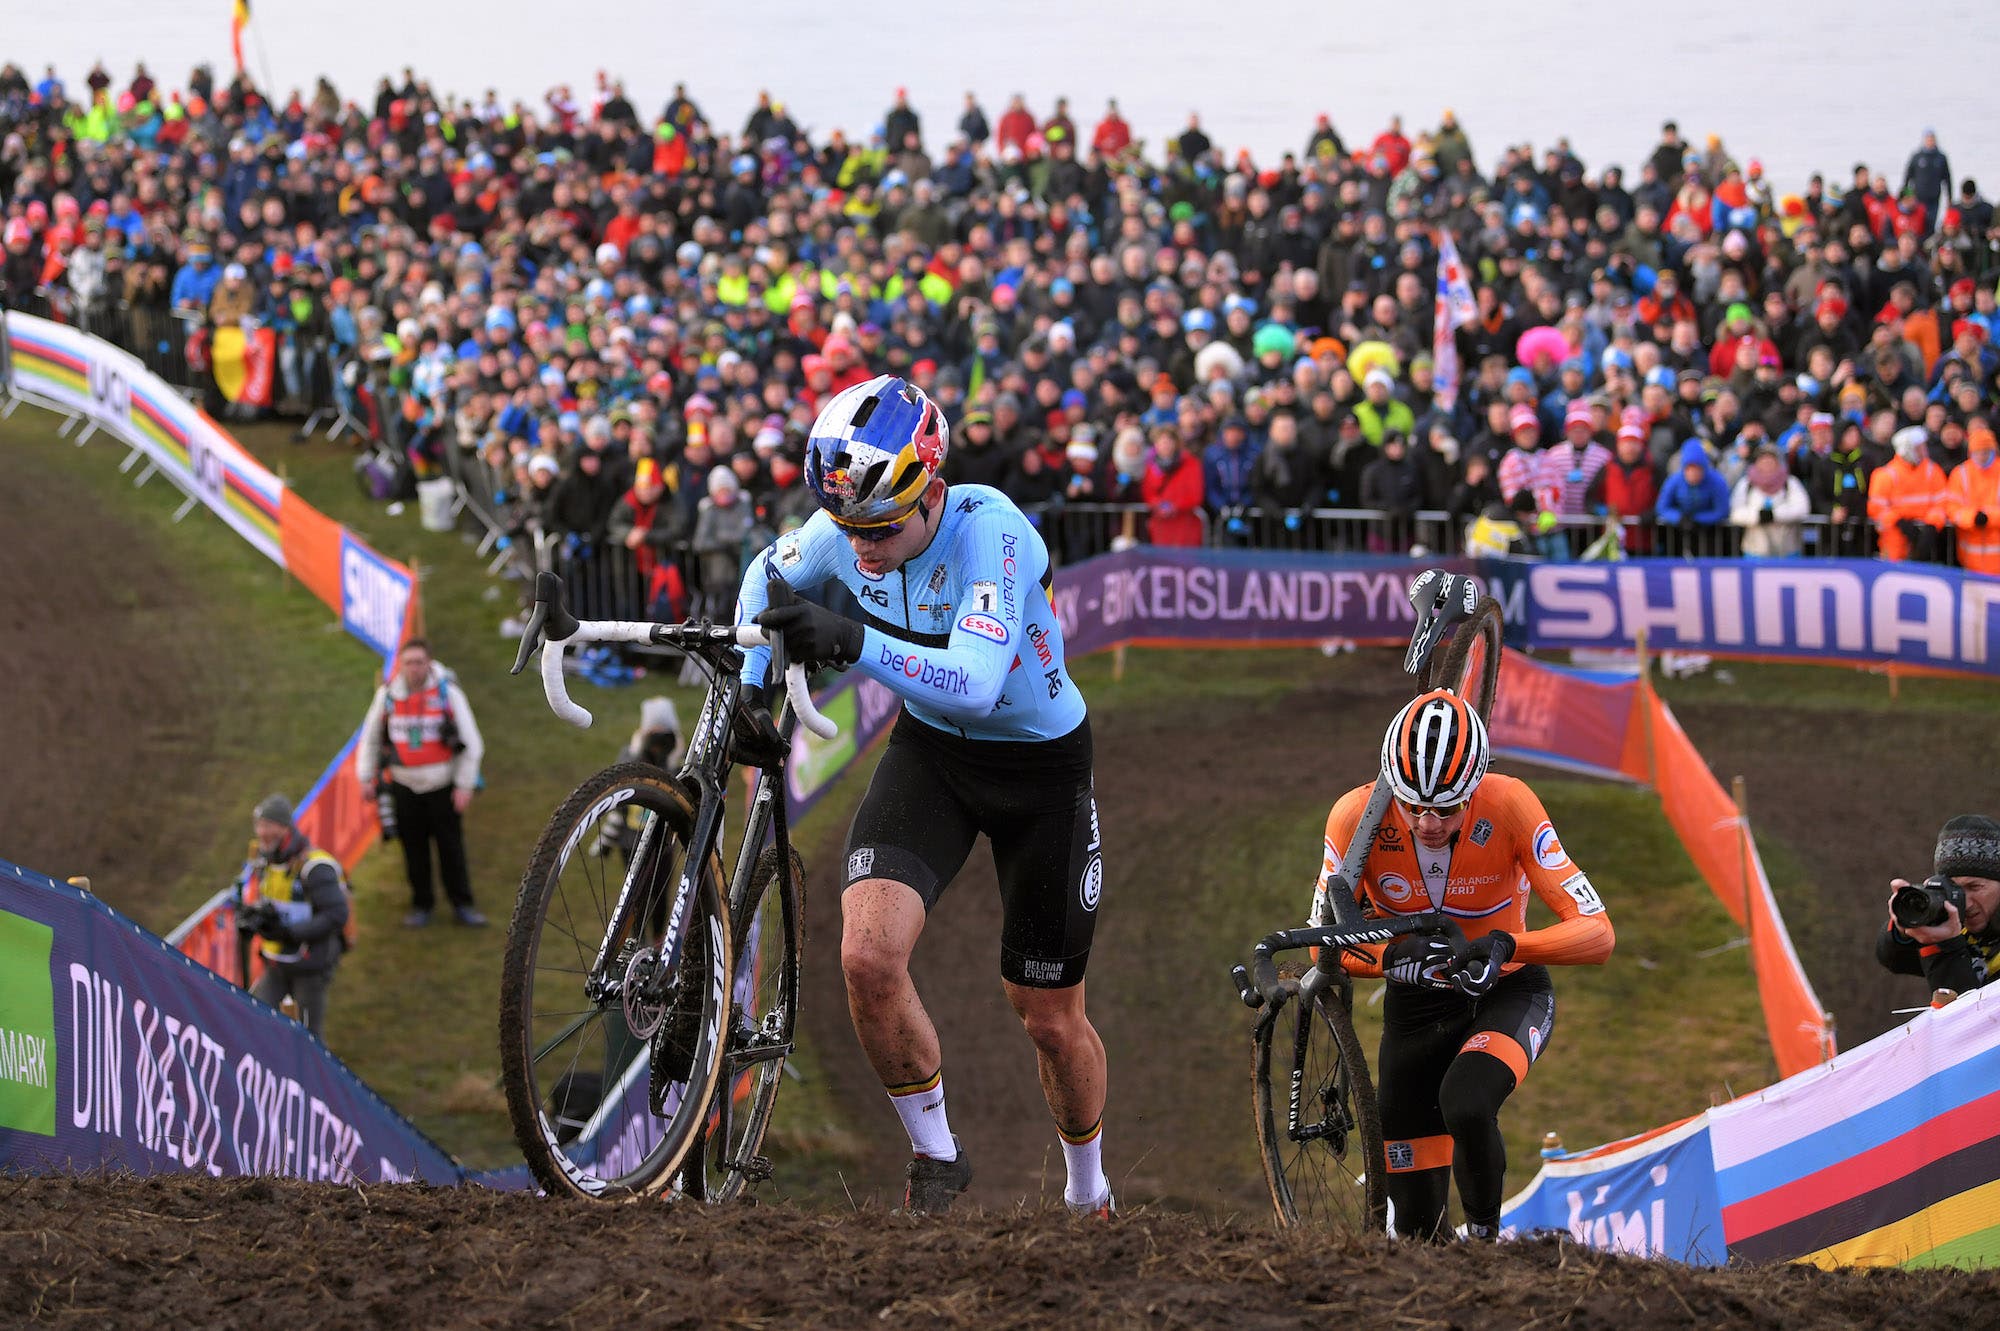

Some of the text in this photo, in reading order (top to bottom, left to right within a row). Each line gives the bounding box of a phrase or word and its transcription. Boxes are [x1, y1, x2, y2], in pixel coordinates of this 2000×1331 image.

[979, 593, 990, 612] 1
[661, 873, 690, 967] STEVENS
[1322, 929, 1394, 947] CANYON
[1024, 968, 1061, 980] CYCLING
[1025, 960, 1063, 971] BELGIAN
[0, 1028, 48, 1088] MARK
[70, 963, 123, 1138] DIN
[1289, 1070, 1300, 1130] CANYON
